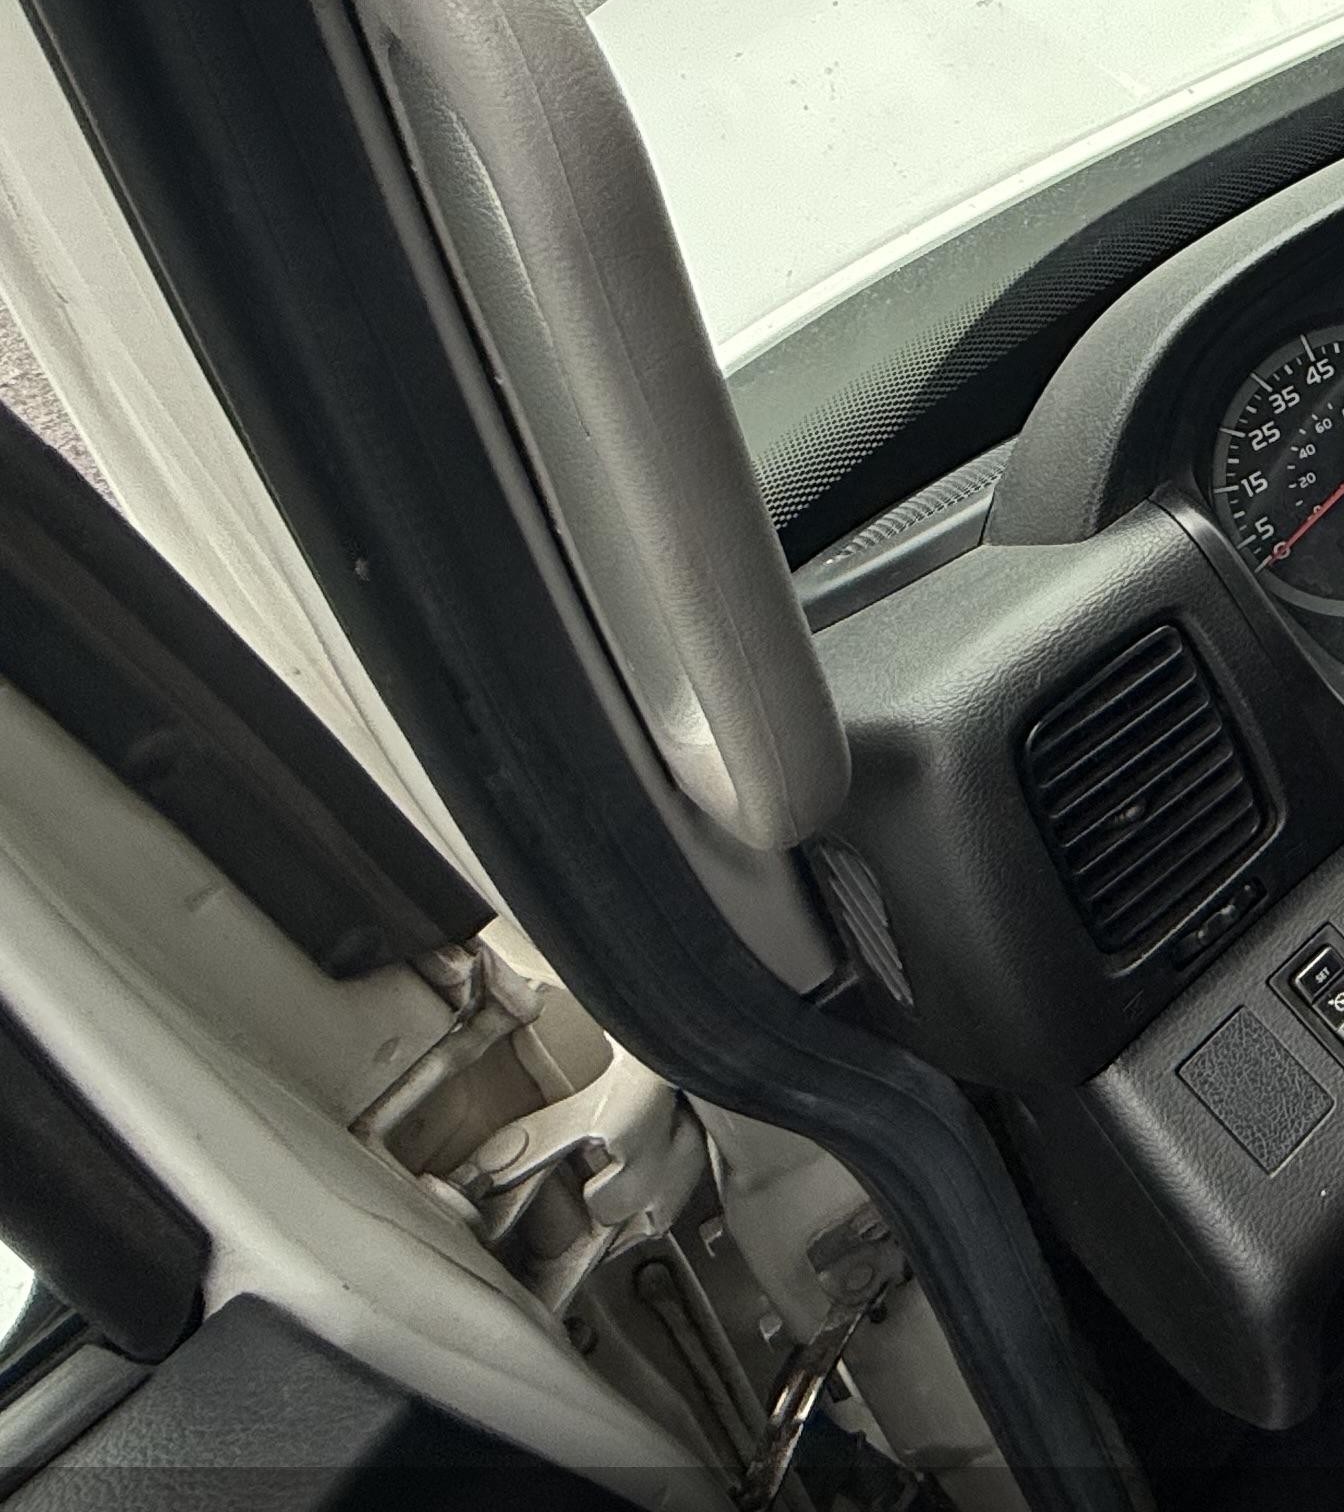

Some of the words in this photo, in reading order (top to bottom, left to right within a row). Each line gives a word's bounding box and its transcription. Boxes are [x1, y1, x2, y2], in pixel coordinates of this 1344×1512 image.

[1306, 358, 1335, 385] 45
[1269, 385, 1300, 414] 35
[1248, 421, 1280, 451] 25
[1315, 418, 1332, 434] 60
[1299, 443, 1316, 460] 40
[1241, 471, 1268, 498] 15
[1299, 472, 1317, 489] 20
[1255, 516, 1274, 540] 5
